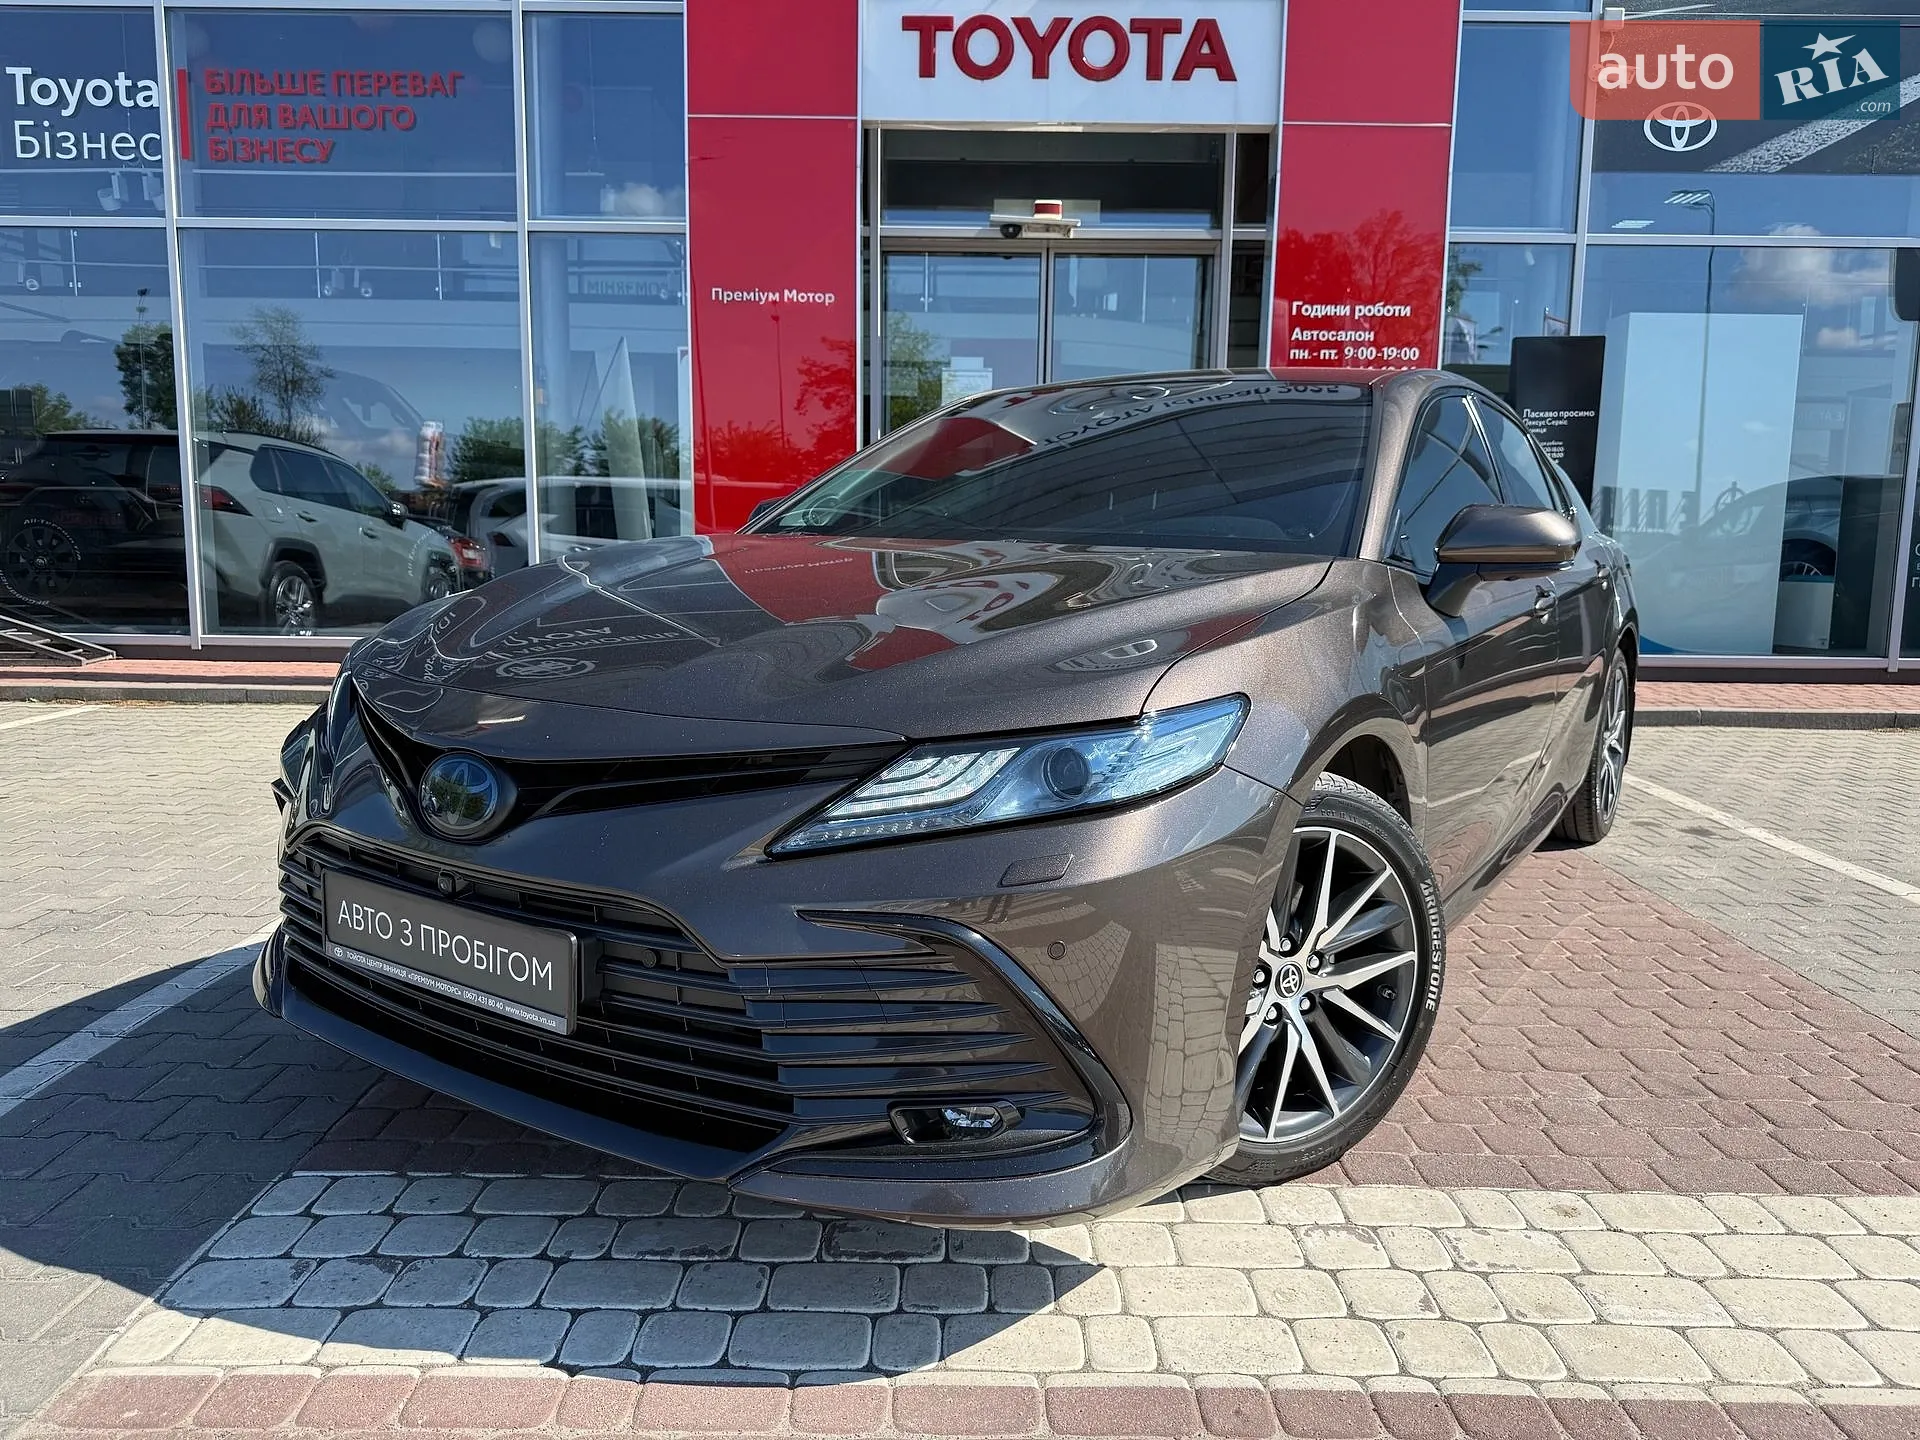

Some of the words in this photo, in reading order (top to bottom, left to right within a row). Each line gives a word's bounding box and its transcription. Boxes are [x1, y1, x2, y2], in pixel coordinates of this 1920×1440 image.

[901, 14, 1237, 83] TOYOTA
[5, 66, 160, 117] Toyota
[204, 69, 324, 95] БІЛЬШЕ
[331, 71, 464, 97] ПЕРЕВАГ
[206, 102, 269, 132] ДЛЯ
[278, 104, 416, 131] ВАШОГО
[14, 119, 162, 161] Бізнес
[208, 136, 335, 163] БІЗНЕСУ
[711, 287, 780, 305] Преміум
[784, 289, 835, 306] Мотор
[1292, 301, 1350, 319] Години
[1354, 302, 1411, 320] роботи
[1291, 327, 1375, 342] Автосалон
[1344, 346, 1420, 361] 9:00-19:00
[1523, 408, 1558, 419] Ласкаво
[1559, 410, 1595, 419] просимо
[338, 900, 393, 940] АВТО
[420, 923, 553, 991] ПРОБІГОМ
[1420, 878, 1442, 1012] BRIDGESTONE
[463, 989, 478, 1002] (067)
[478, 996, 488, 1006] 431
[488, 998, 496, 1007] 80
[496, 1002, 504, 1010] 40
